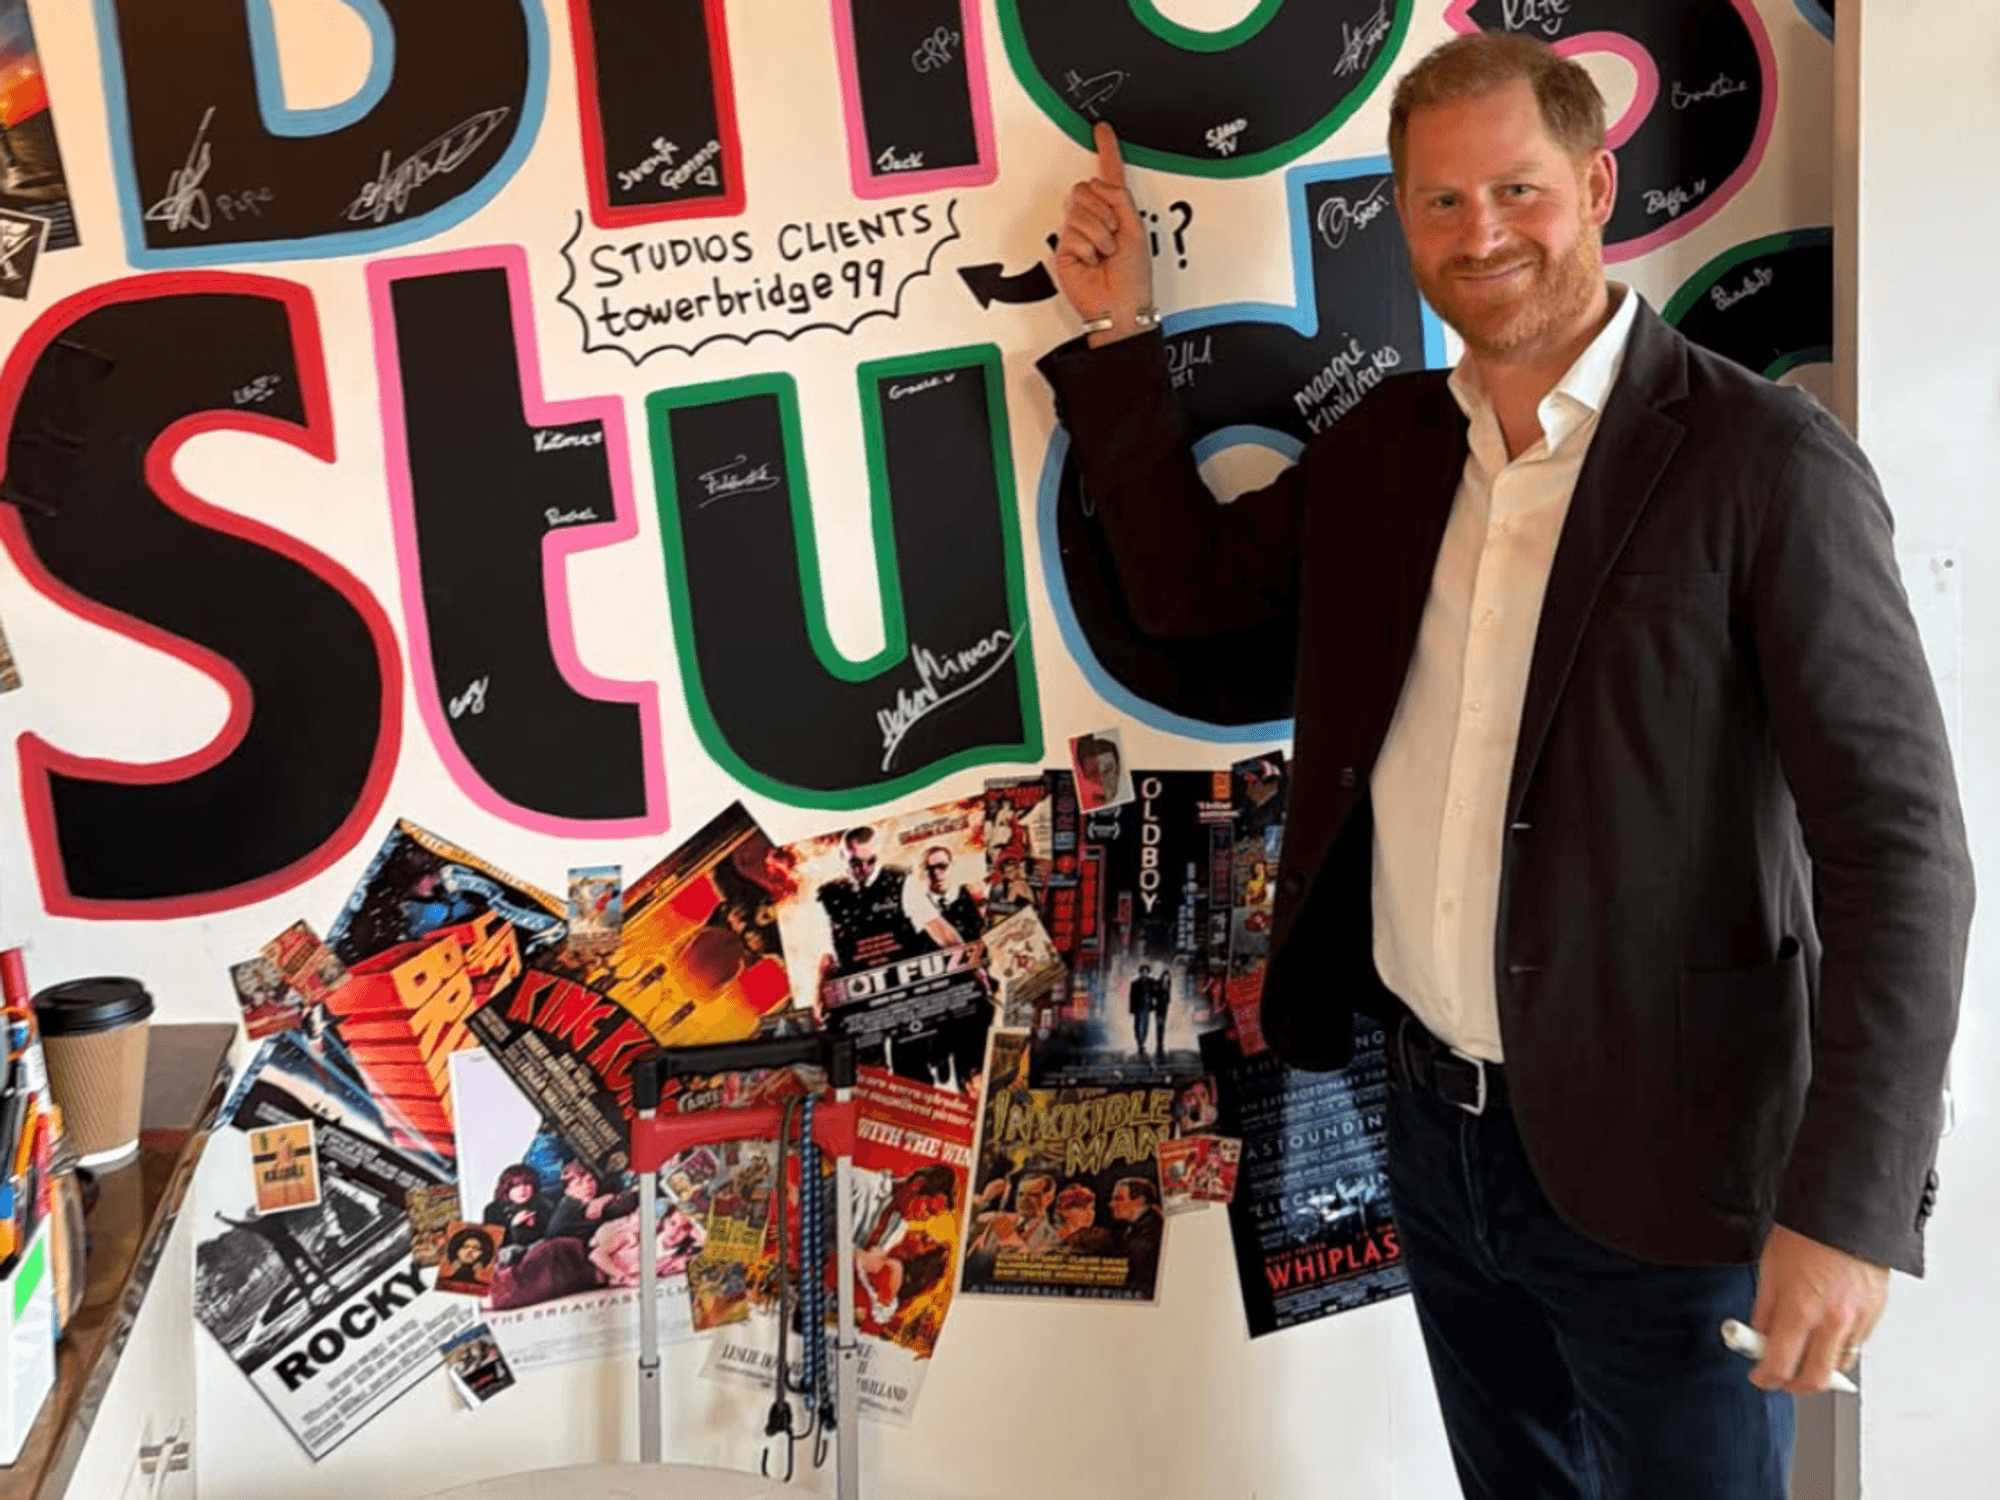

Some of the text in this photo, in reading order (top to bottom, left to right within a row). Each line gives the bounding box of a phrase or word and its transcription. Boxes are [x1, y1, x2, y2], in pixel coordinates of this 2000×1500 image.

[876, 145, 924, 172] Jack
[590, 204, 932, 289] STUDIOS CLIENTS
[1139, 776, 1163, 914] OLDBOY
[506, 968, 618, 1053] KING
[821, 972, 888, 1010] HOT
[903, 1130, 943, 1159] THE
[941, 1140, 973, 1168] WIN
[1064, 1124, 1171, 1178] MAN
[1247, 1113, 1383, 1159] ASTOUNDIN
[1264, 1232, 1401, 1292] WHIPLAS
[272, 1259, 429, 1393] ROCKY
[533, 1293, 643, 1320] BREAKFAS
